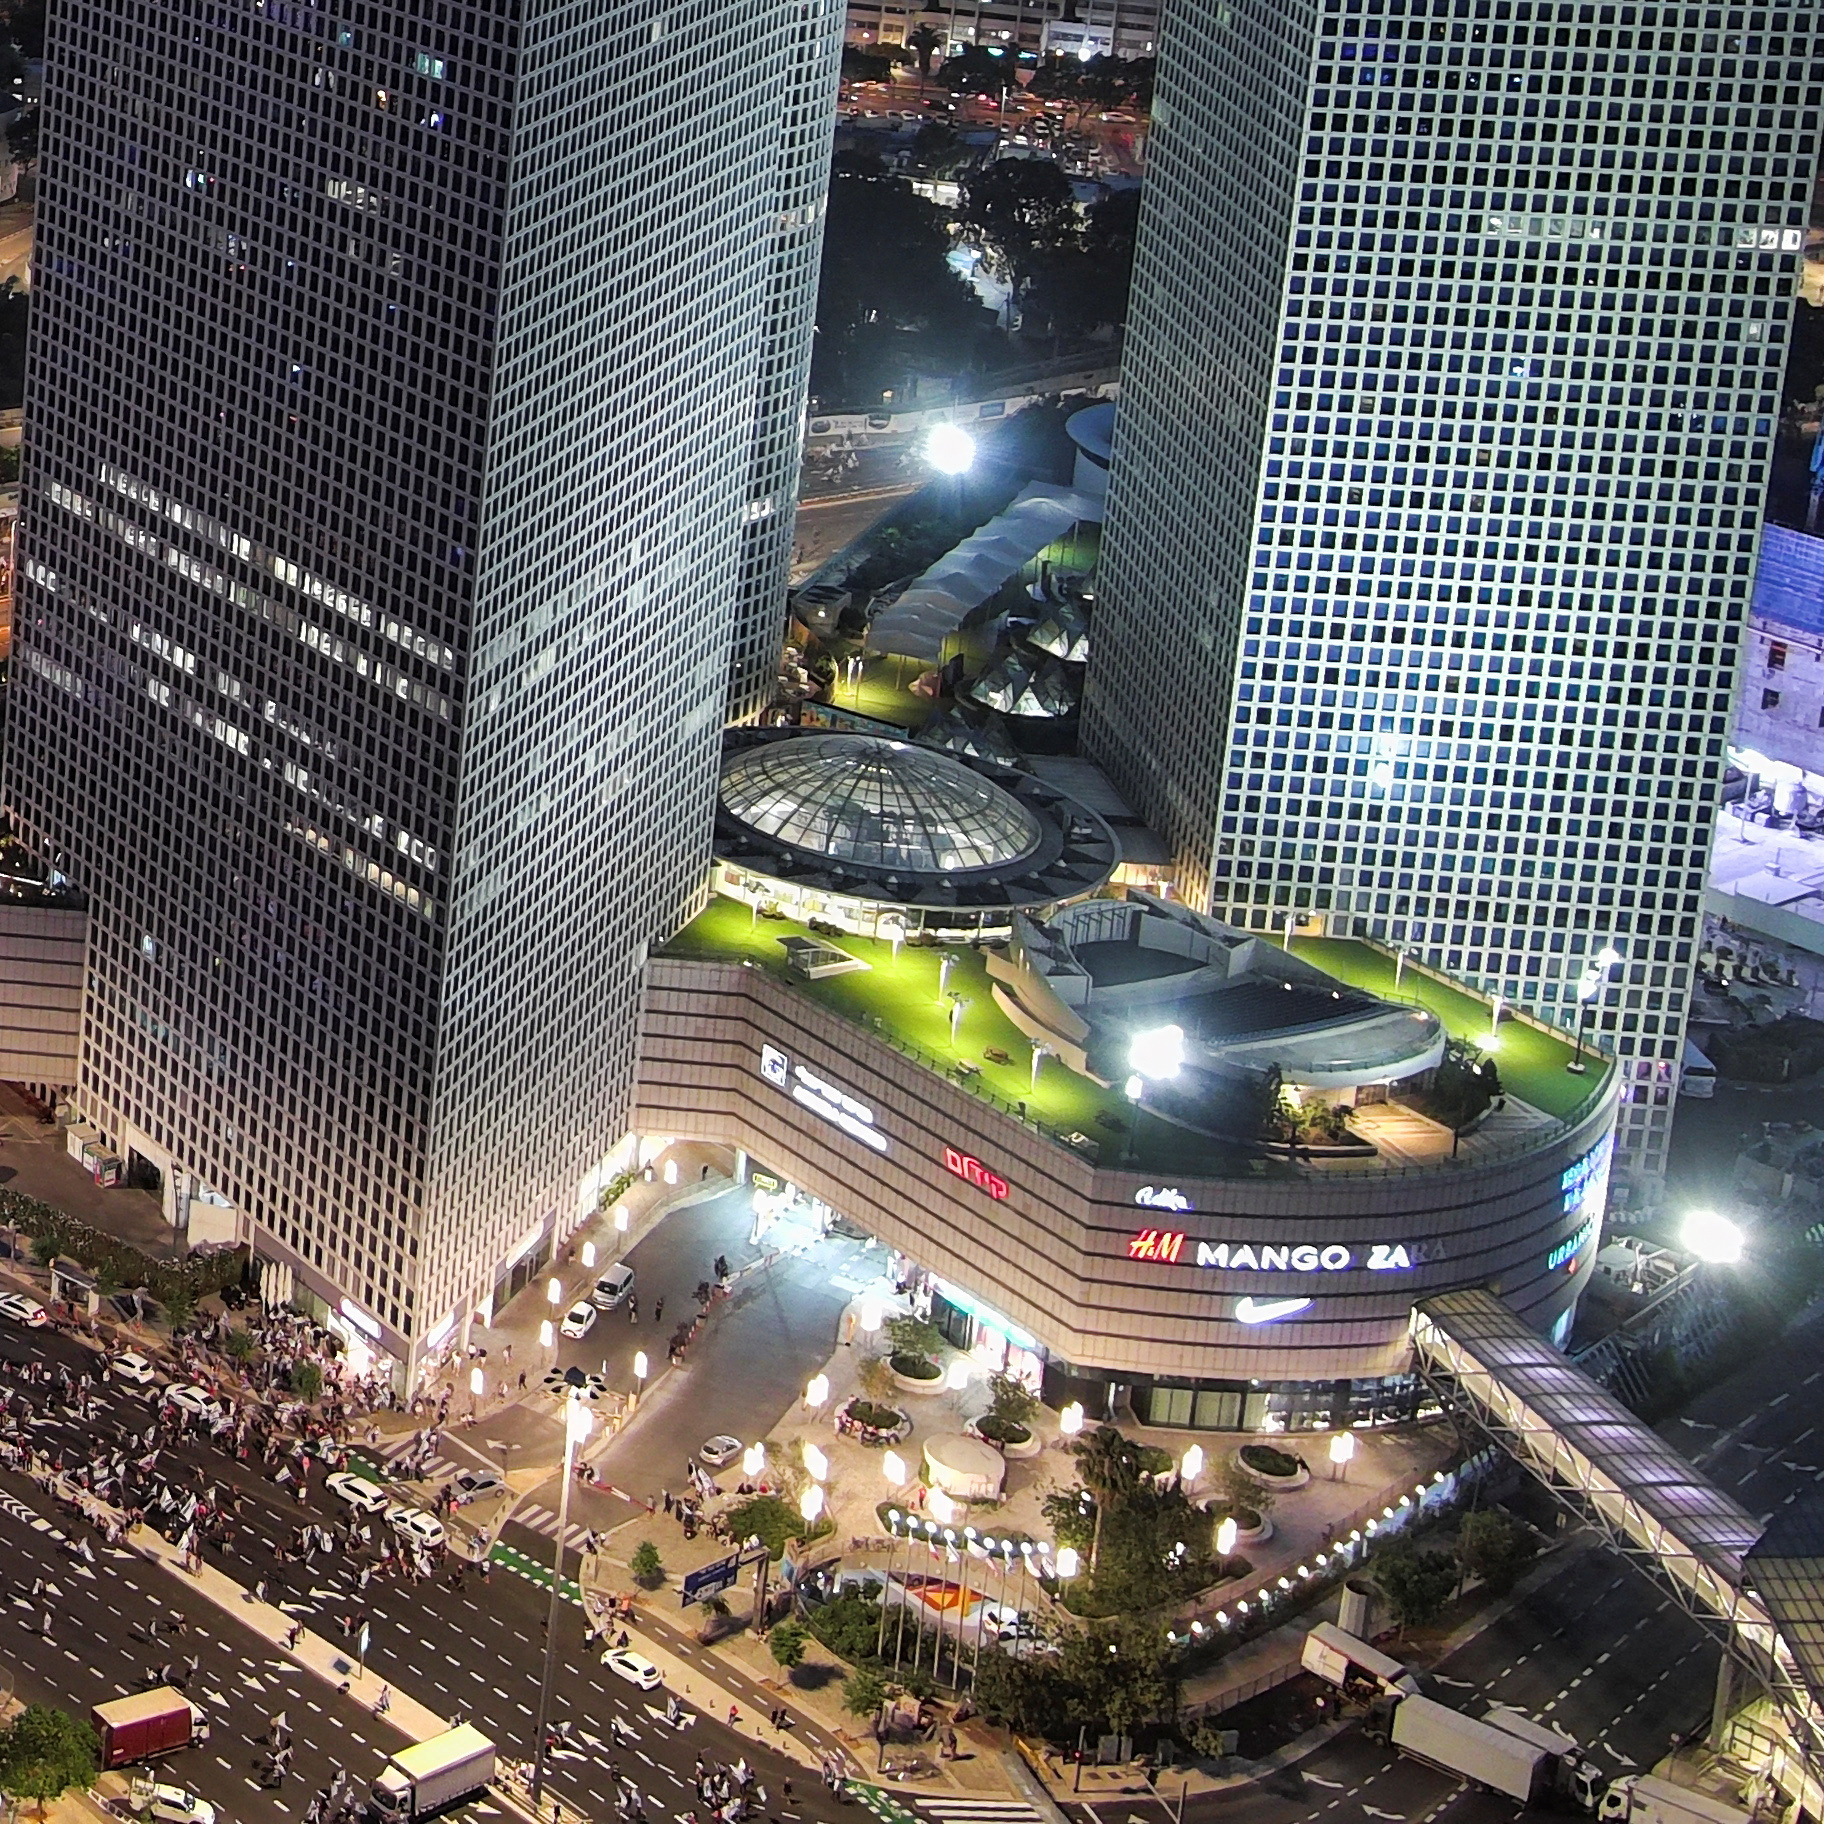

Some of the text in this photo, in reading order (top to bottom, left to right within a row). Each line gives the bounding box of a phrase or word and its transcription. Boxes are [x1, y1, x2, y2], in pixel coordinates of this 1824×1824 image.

[942, 1147, 1011, 1200] קידום
[1129, 1229, 1184, 1263] H&M
[1196, 1241, 1350, 1271] MANGO
[1366, 1240, 1447, 1270] ZARA
